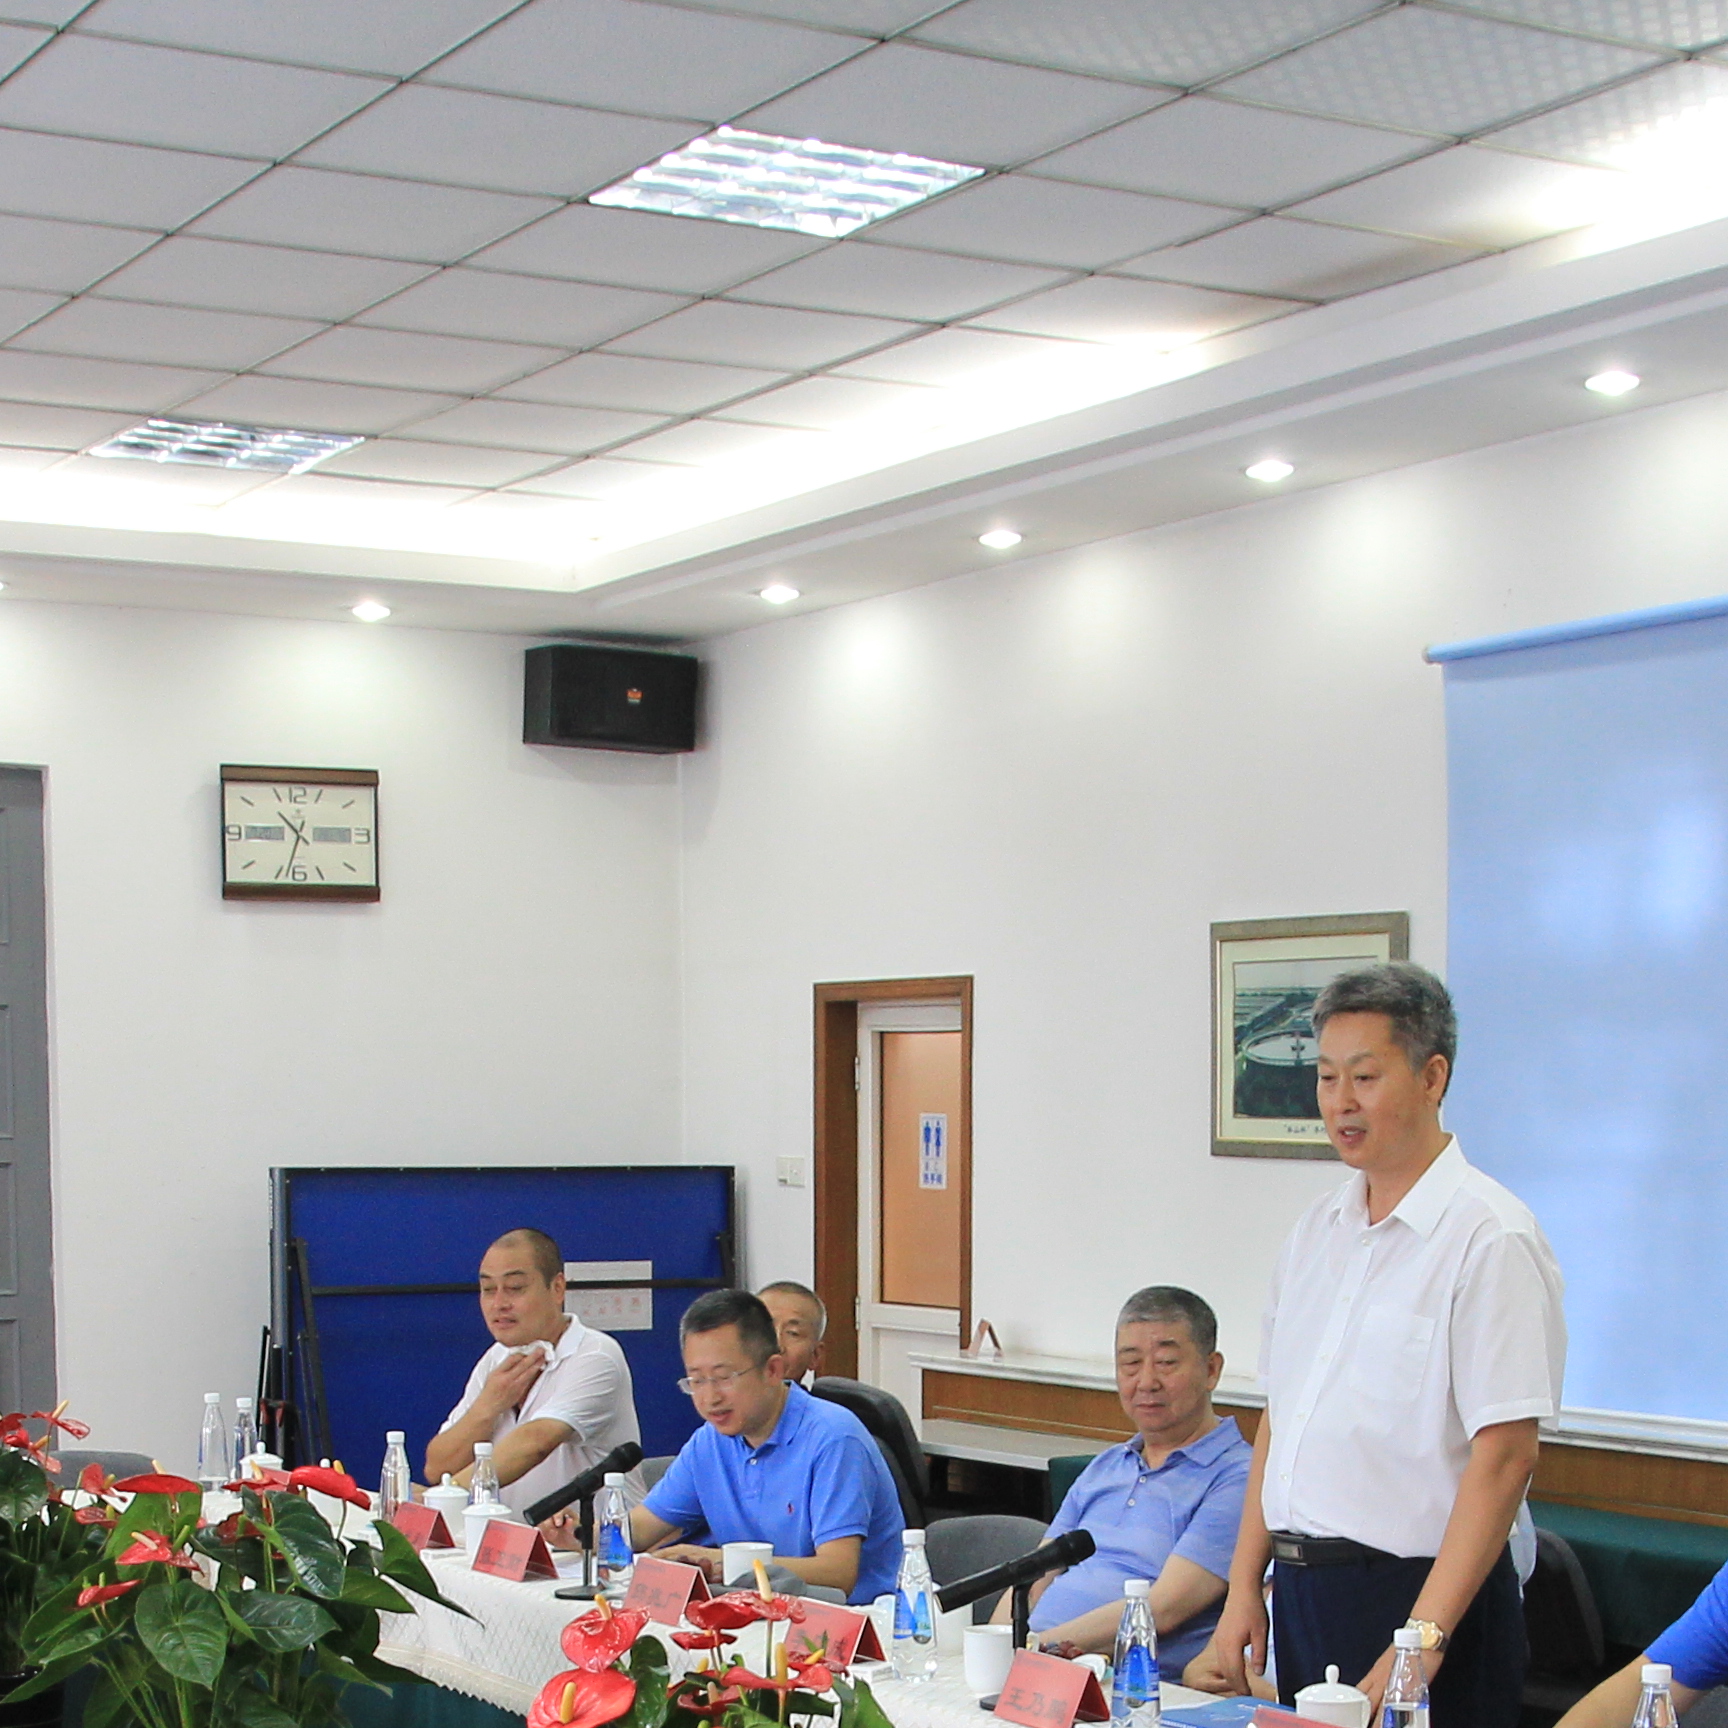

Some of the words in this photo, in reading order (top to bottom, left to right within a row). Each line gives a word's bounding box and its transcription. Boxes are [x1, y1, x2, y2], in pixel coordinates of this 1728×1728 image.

[288, 786, 307, 805] 12
[226, 824, 242, 841] 9
[354, 827, 371, 844] 3
[292, 865, 308, 882] 6
